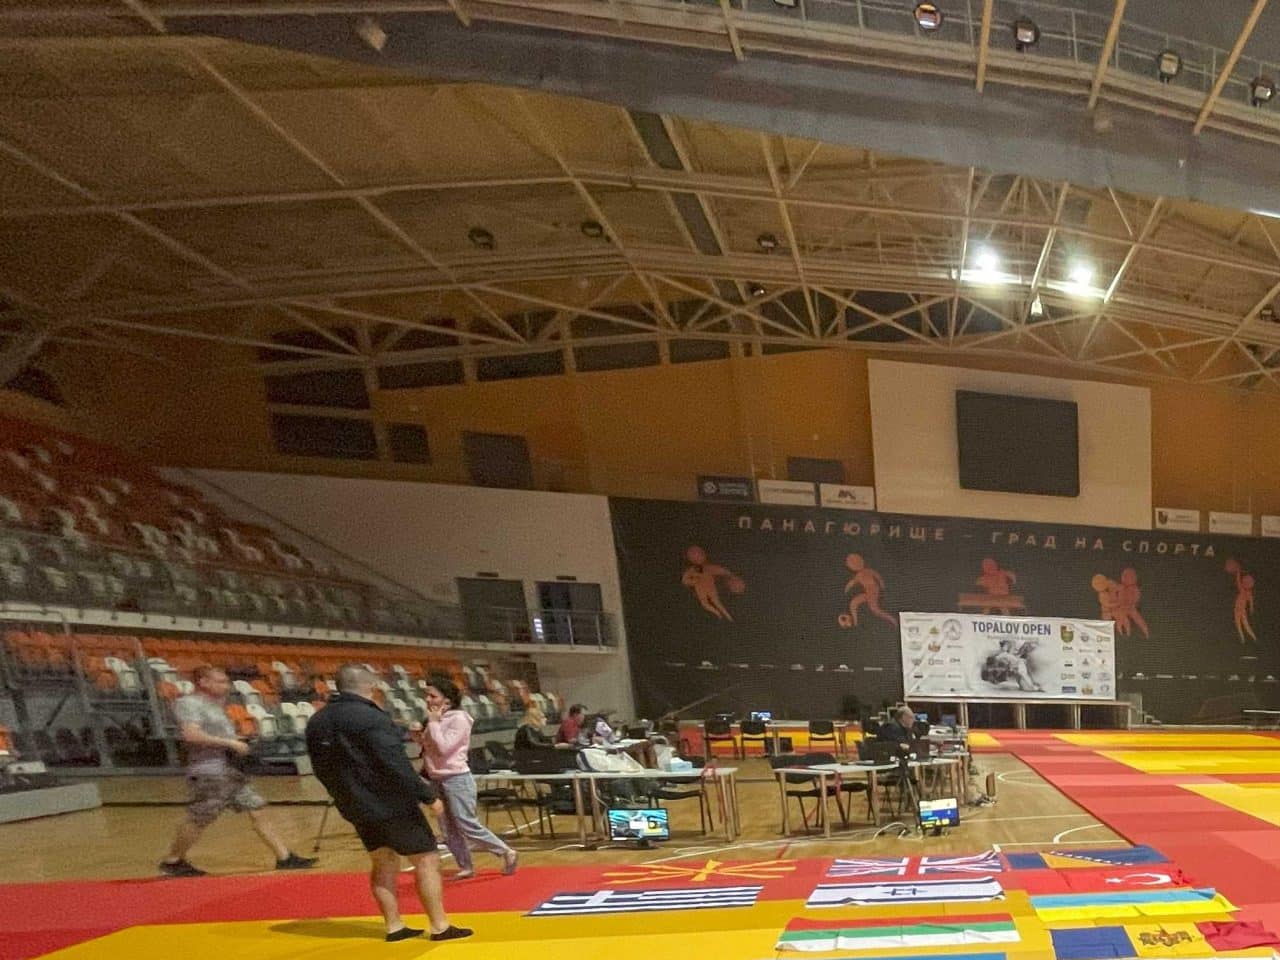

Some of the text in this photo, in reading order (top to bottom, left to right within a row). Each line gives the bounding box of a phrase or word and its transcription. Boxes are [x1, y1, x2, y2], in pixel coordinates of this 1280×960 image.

[738, 516, 945, 541] ПАНАГЮРИЩЕ
[992, 531, 1056, 550] ГРАД
[1075, 537, 1104, 551] НА
[1122, 540, 1216, 557] СПОРТА
[971, 621, 1051, 635] TOPALOV OPEN
